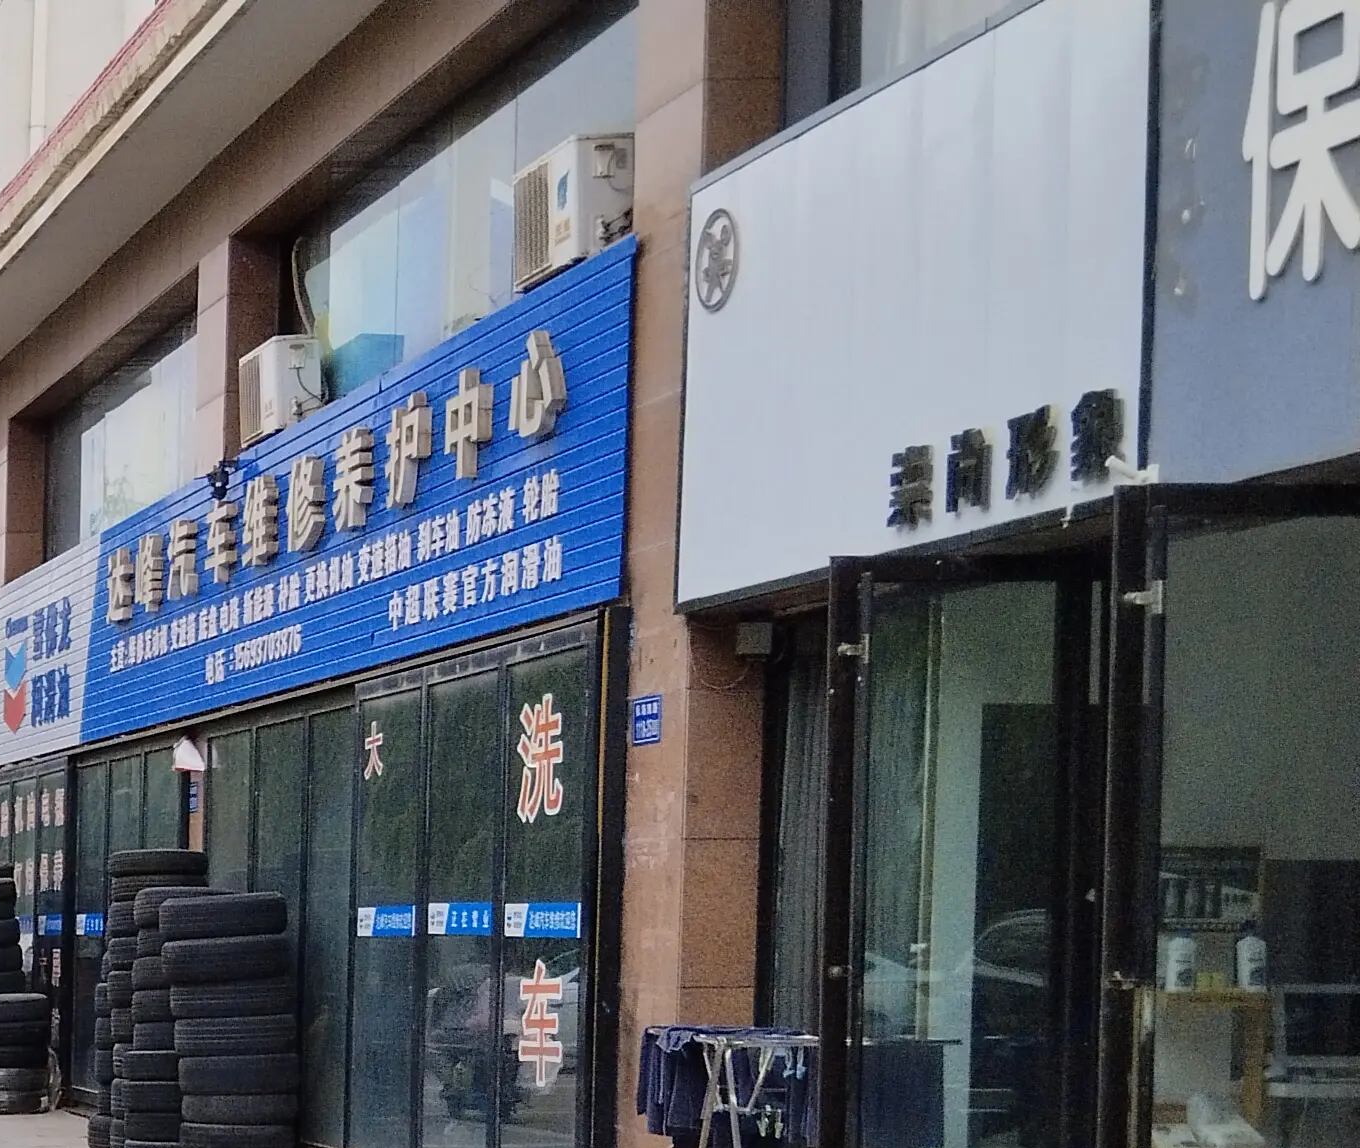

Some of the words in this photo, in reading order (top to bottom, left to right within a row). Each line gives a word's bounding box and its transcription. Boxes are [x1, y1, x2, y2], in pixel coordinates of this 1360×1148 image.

[1242, 0, 1360, 300] 保
[106, 330, 567, 625] 达峰汽车维修养护中心
[466, 484, 516, 545] 防冻液
[522, 468, 561, 524] 轮胎
[388, 534, 563, 631] 中超联赛官方润滑油
[364, 721, 384, 780] 大
